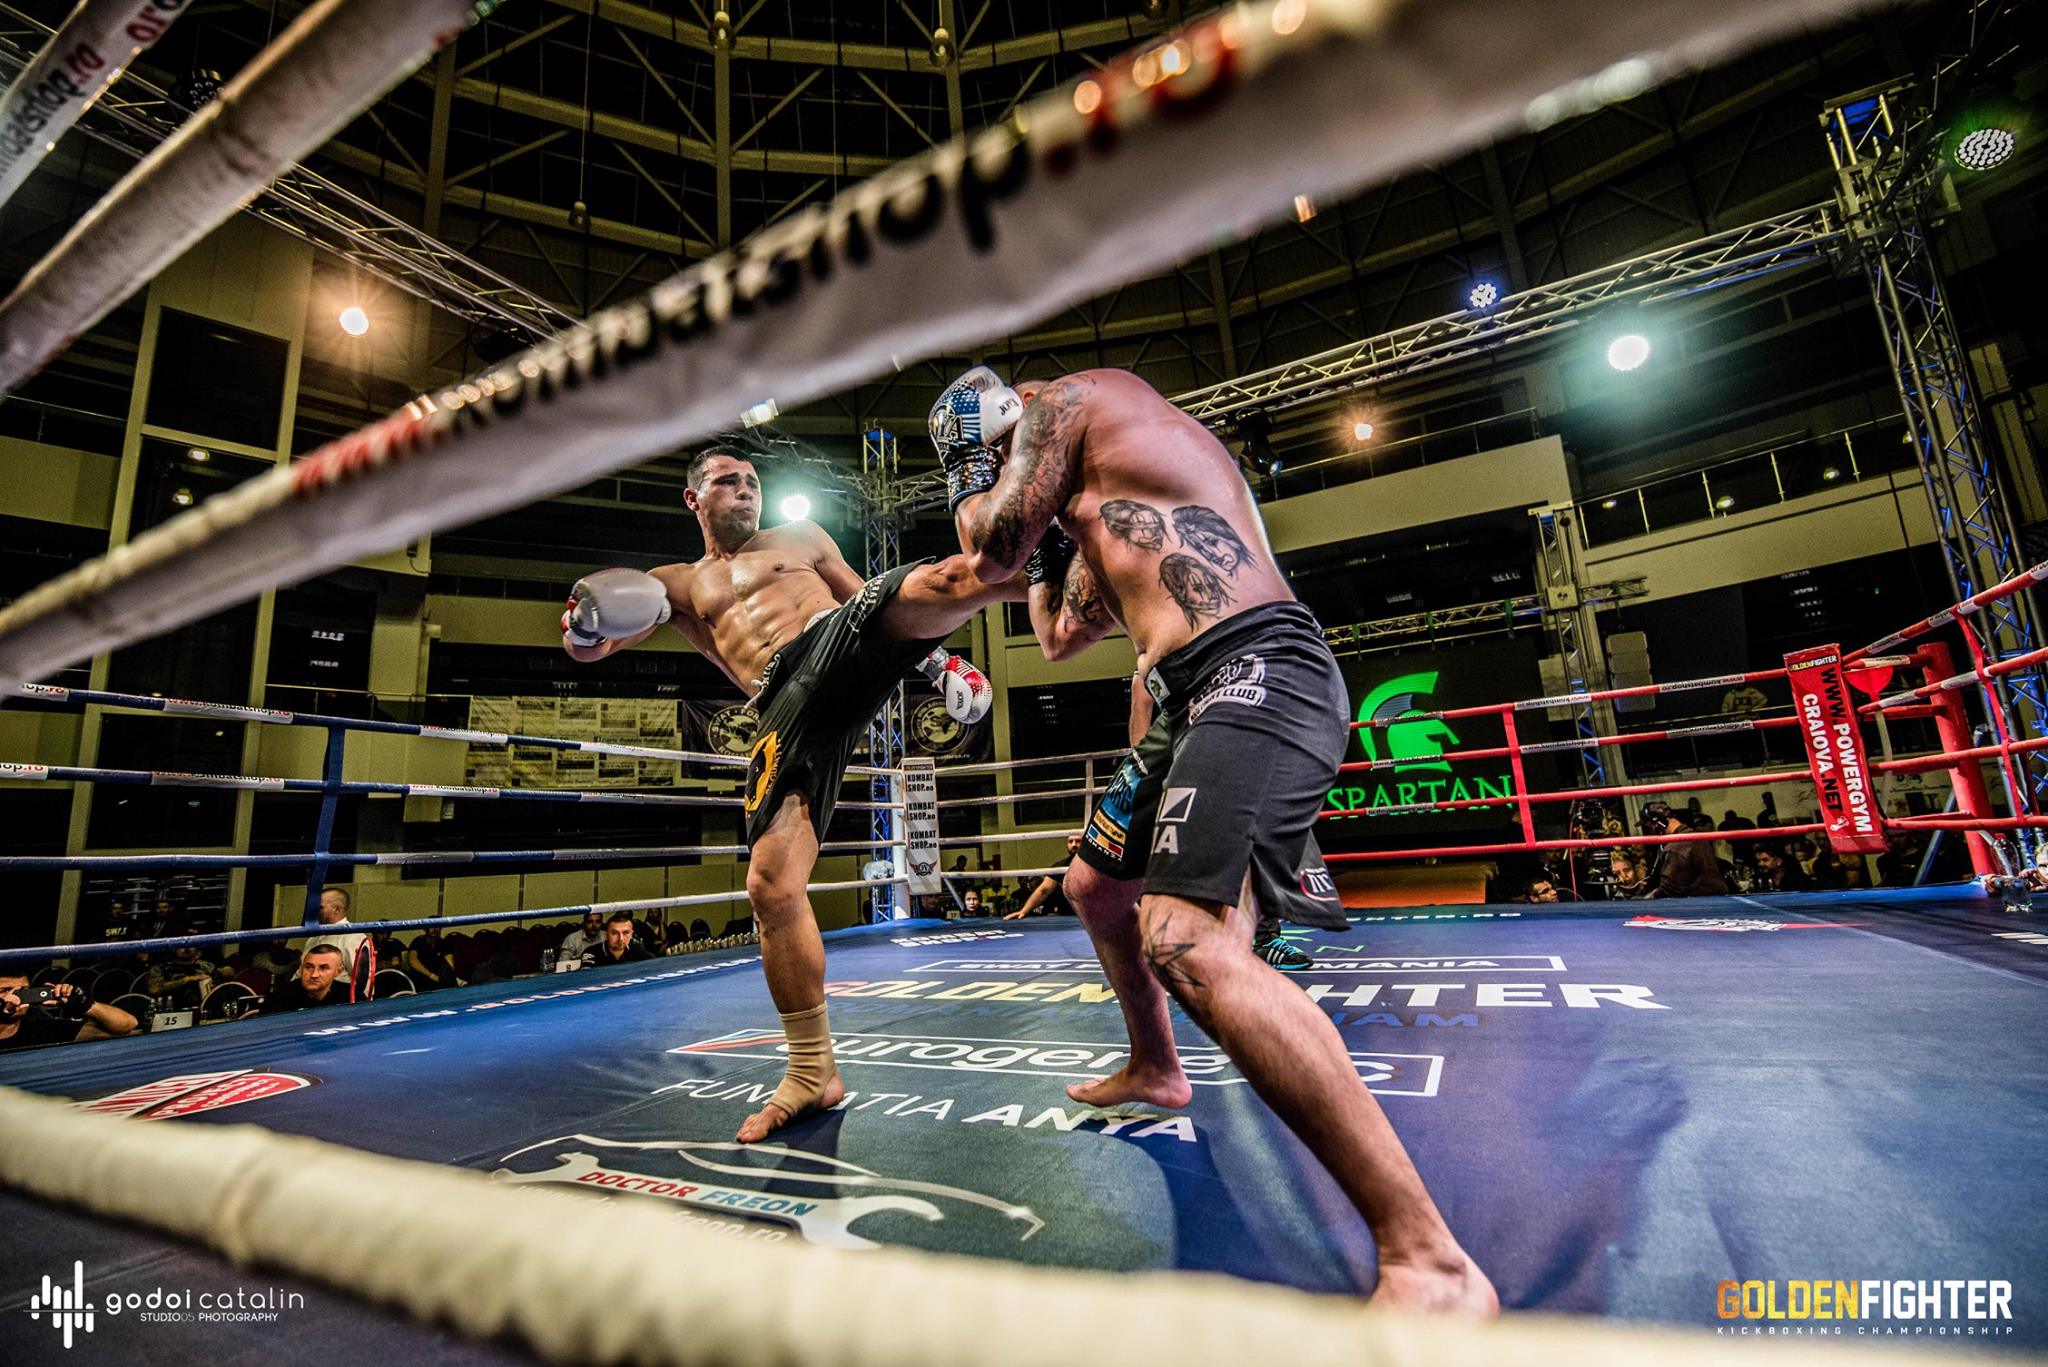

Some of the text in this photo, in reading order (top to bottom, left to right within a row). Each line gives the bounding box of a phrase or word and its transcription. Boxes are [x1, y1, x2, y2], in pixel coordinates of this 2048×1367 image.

[1222, 687, 1257, 701] CLUB
[1802, 693, 1843, 813] CRAIOVA.NET
[907, 773, 933, 782] KOMBAT
[908, 801, 935, 811] KOMBAT
[1327, 774, 1512, 820] SPARTAN
[910, 829, 936, 840] KOMBAT
[1302, 983, 1672, 1010] HTER
[164, 1016, 177, 1026] 15
[961, 1103, 1198, 1142] ANYA
[577, 1171, 699, 1198] DOCTOR
[698, 1190, 819, 1217] FREON
